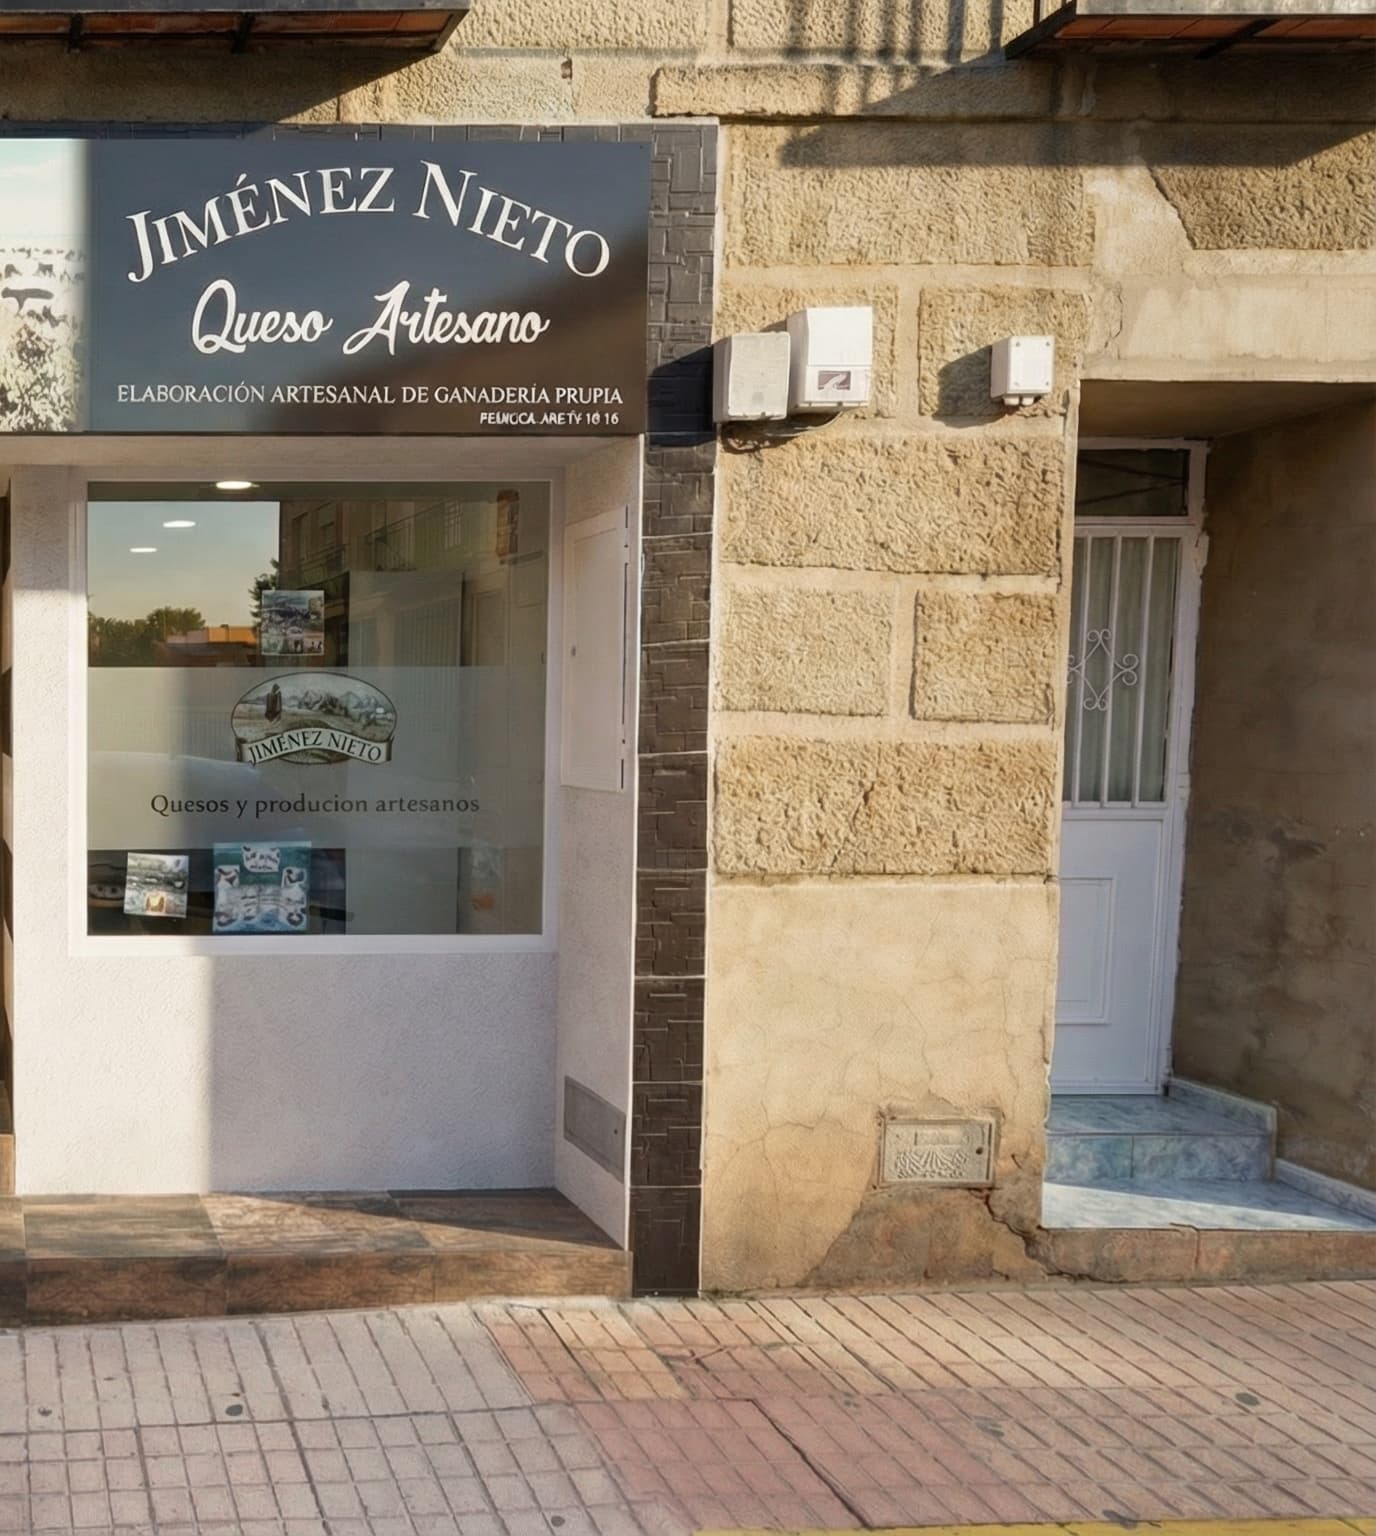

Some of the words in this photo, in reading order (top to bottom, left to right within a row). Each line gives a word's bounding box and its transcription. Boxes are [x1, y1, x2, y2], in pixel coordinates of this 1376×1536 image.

[125, 166, 396, 283] JIMÉNEZ
[412, 159, 611, 278] NIETO
[191, 278, 334, 355] Queso
[342, 280, 551, 356] Artesano
[117, 380, 265, 403] ELABORACIÓN
[269, 385, 396, 404] ARTESANAL
[401, 386, 429, 404] DE
[434, 383, 551, 405] GANADERÍA
[327, 731, 382, 762] NIETO
[150, 794, 229, 818] Quesos
[235, 798, 248, 819] y
[255, 792, 368, 819] producion
[374, 796, 480, 813] artesanos
